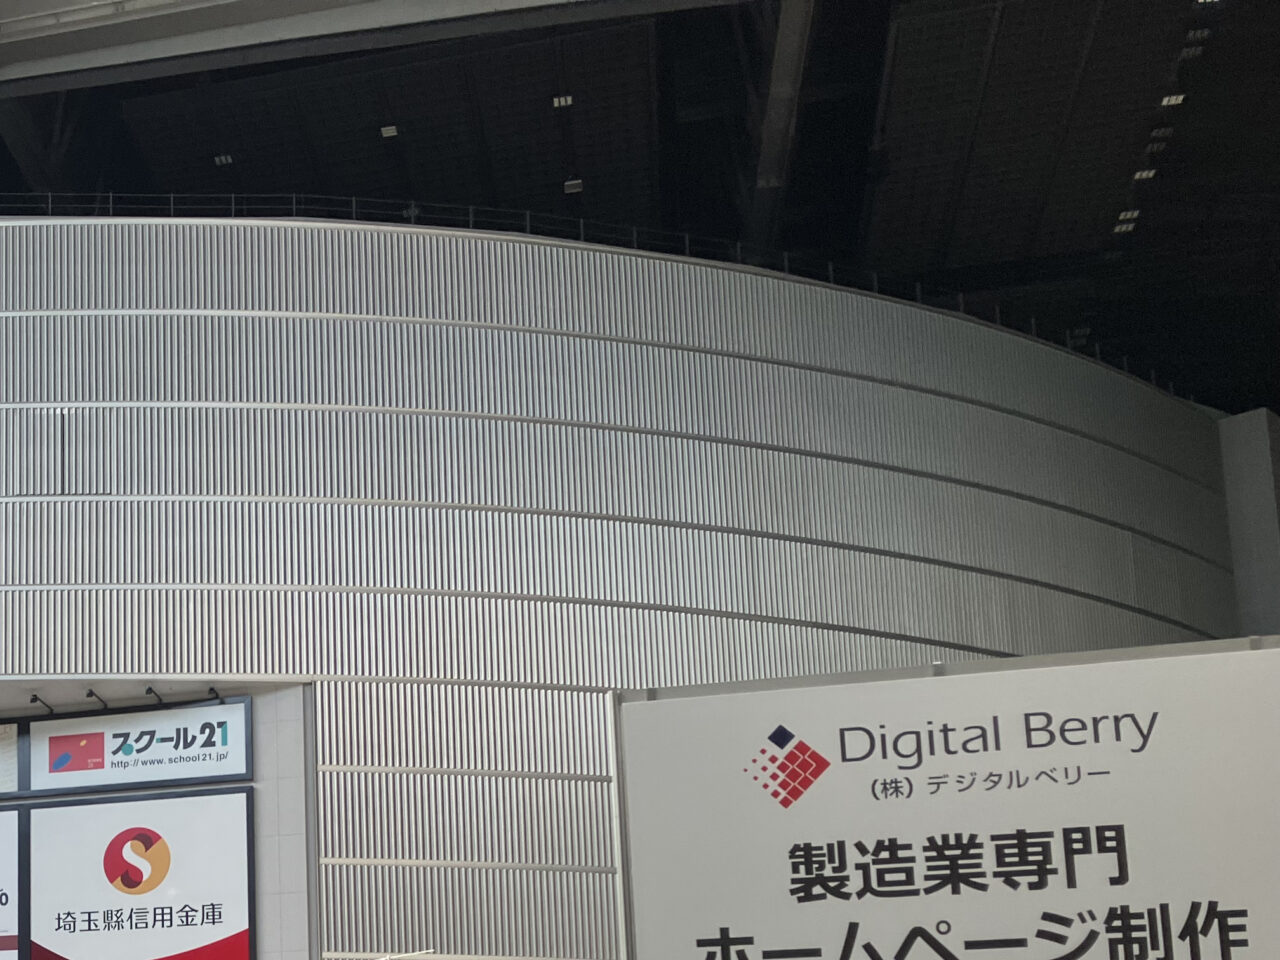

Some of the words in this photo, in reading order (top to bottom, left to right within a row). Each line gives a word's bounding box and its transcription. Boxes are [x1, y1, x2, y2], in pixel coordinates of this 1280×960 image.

[111, 720, 229, 757] スクール21
[838, 714, 1002, 771] Digital
[1022, 710, 1160, 754] Berry
[926, 766, 1112, 797] デジタルベリー
[788, 823, 1130, 904] 製造業専門
[54, 903, 224, 934] 埼玉縣信用金庫
